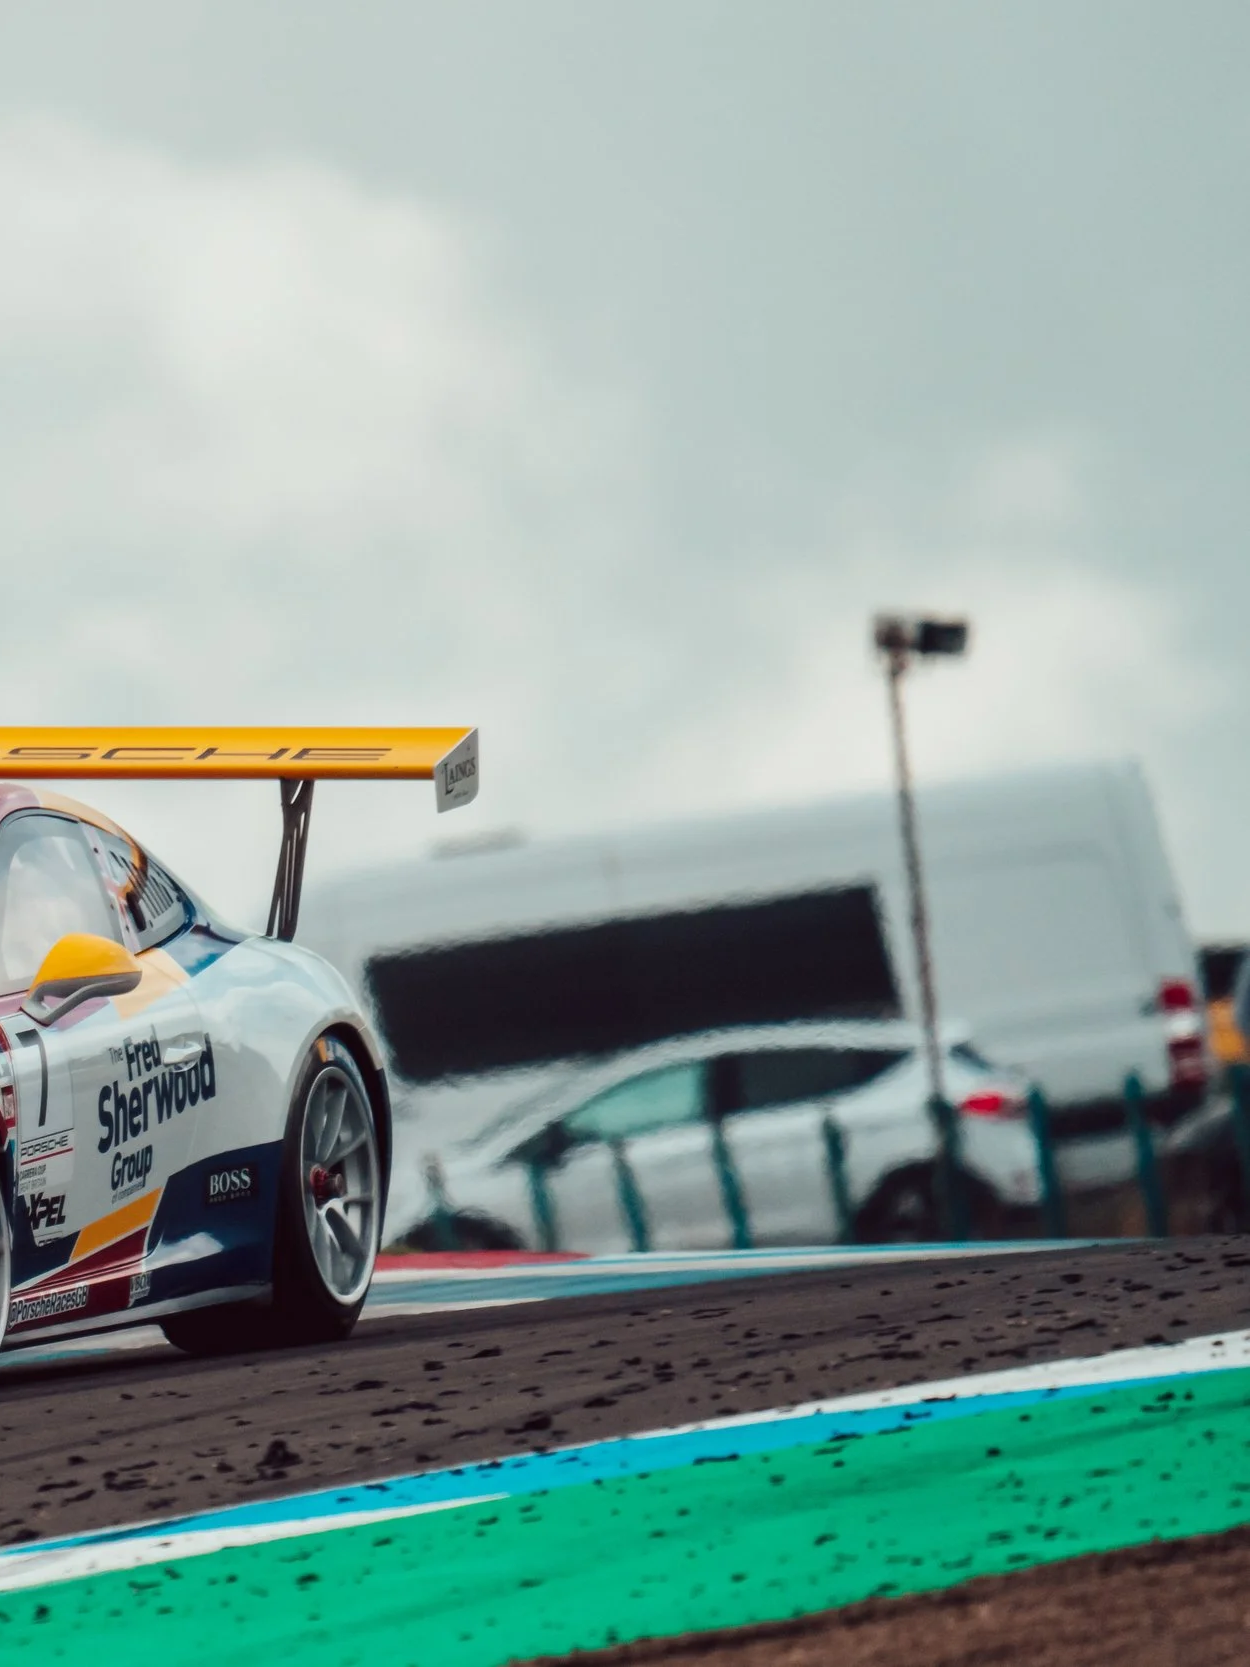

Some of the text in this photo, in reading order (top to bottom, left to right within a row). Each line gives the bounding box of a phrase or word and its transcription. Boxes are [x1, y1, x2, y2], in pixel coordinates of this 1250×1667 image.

[108, 1024, 162, 1082] The Fred
[15, 1028, 48, 1127] 7
[97, 1032, 216, 1154] Sherwood
[20, 1135, 69, 1157] PORSCHE
[111, 1144, 153, 1191] Group
[210, 1168, 251, 1196] BOSS
[29, 1192, 66, 1230] XPEL
